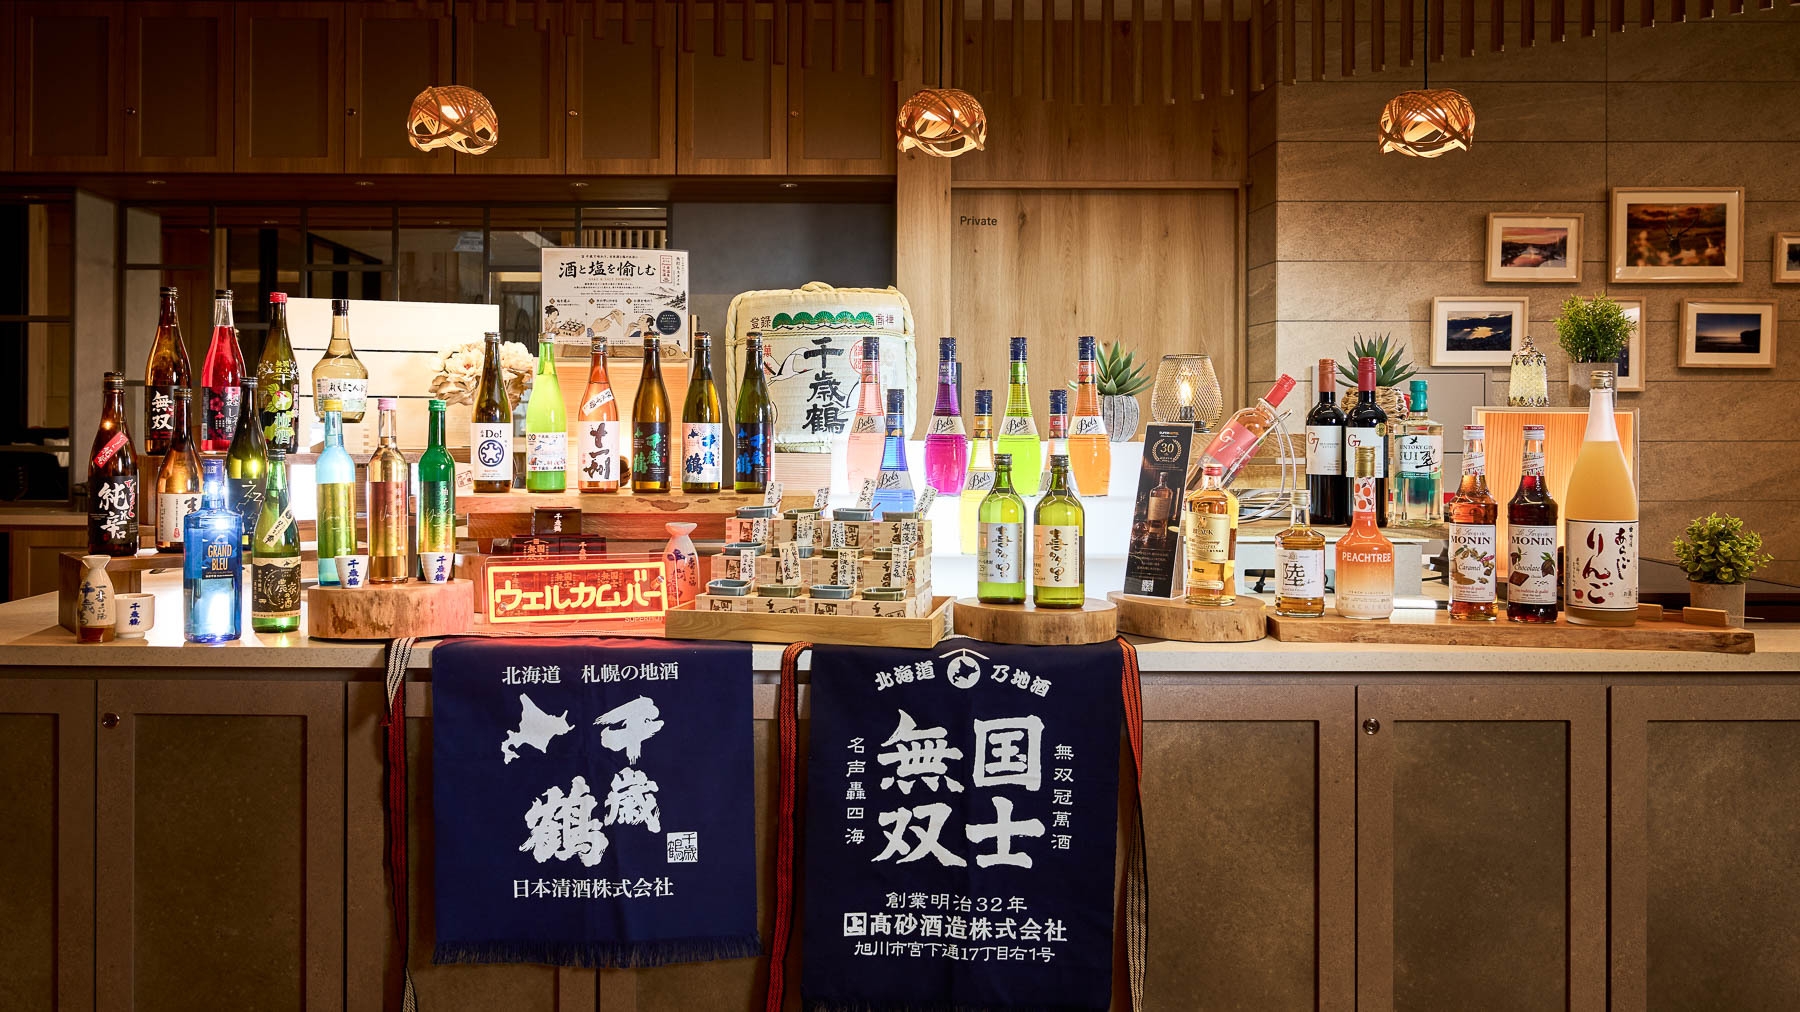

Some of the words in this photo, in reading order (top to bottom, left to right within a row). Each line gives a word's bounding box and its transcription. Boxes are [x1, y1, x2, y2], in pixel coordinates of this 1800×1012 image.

[960, 216, 997, 226] Private
[558, 261, 657, 278] 酒と塩を愉しむ
[750, 315, 771, 330] 登録
[801, 337, 849, 434] 千歳鶴
[485, 430, 502, 439] Do!
[1307, 432, 1320, 453] G7
[1160, 442, 1175, 453] 30
[1451, 535, 1491, 545] MONIN
[1511, 536, 1553, 546] MONIN
[207, 544, 232, 558] GRAND
[1342, 551, 1392, 563] PEACHTREE
[211, 558, 228, 571] BLEU
[1458, 562, 1482, 571] Caramel
[1514, 563, 1542, 572] Chocolate
[1582, 528, 1613, 604] りんご
[494, 569, 663, 611] ウェルカムバー
[501, 665, 562, 685] 北海道
[581, 661, 680, 684] 札幌の地酒
[874, 660, 936, 691] 北海道
[991, 663, 1053, 697] 乃地酒
[844, 736, 867, 845] 名声轟四海
[870, 709, 968, 868] 無双
[965, 715, 1046, 869] 国士
[1050, 743, 1075, 850] 無双冠萬酒
[512, 877, 675, 898] 日本清酒株式会社
[886, 892, 1028, 913] 創業明治32年
[853, 941, 1056, 963] 旭川市宮下通17丁目右1号
